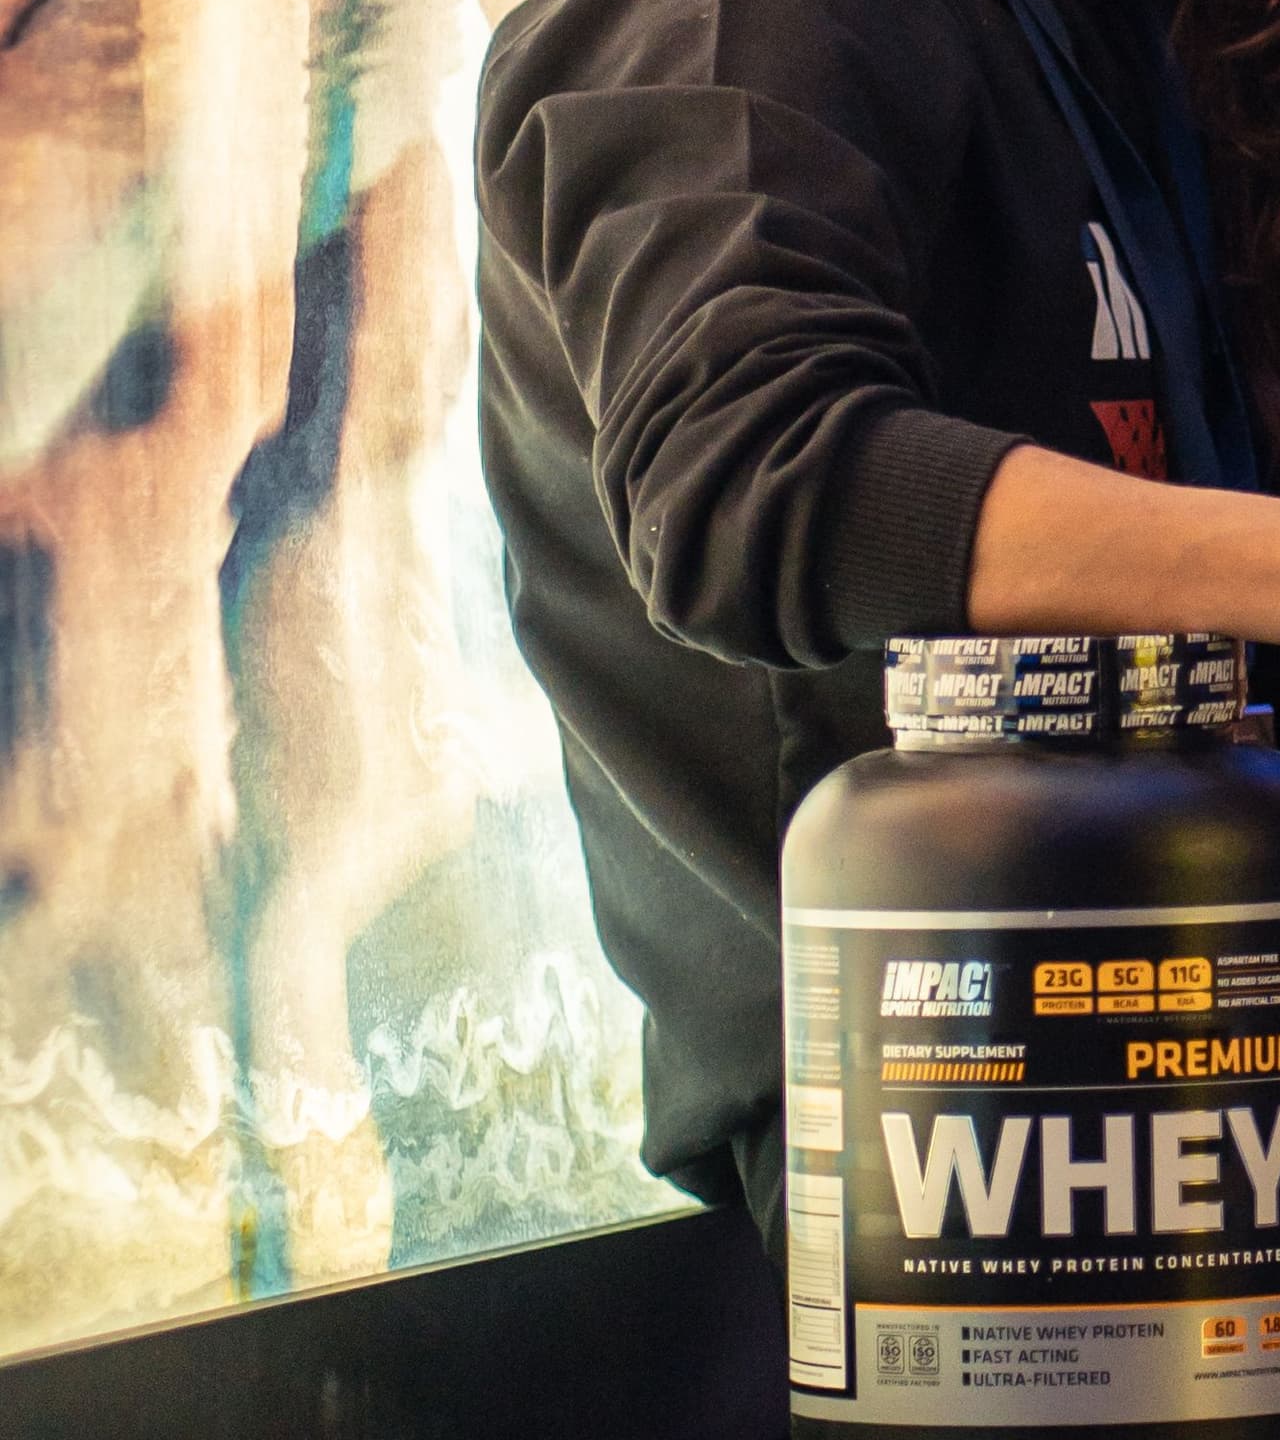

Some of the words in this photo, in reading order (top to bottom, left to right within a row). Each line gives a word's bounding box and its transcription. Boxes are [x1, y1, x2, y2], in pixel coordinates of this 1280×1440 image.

[1041, 654, 1089, 664] NUTRITION
[1042, 696, 1090, 706] NUTRITION
[1044, 969, 1083, 987] 23G
[1217, 978, 1229, 987] NO
[1231, 976, 1256, 987] ADDED
[880, 1001, 921, 1016] SPORT
[921, 1001, 992, 1016] NUTRITION
[1042, 1000, 1085, 1009] PROTEIN
[1113, 999, 1139, 1008] BCAA
[1218, 999, 1229, 1008] NO
[882, 1045, 932, 1058] DIETARY
[935, 1045, 1026, 1058] SUPPLEMENT
[904, 1259, 972, 1274] NATIVE
[982, 1258, 1041, 1274] WHEY
[1052, 1256, 1144, 1273] PROTEIN
[973, 1326, 1033, 1340] NATIVE
[1036, 1325, 1087, 1339] WHEY
[1092, 1323, 1164, 1338] PROTEIN
[1215, 1321, 1235, 1337] 60
[881, 1346, 901, 1357] ISO
[913, 1346, 935, 1358] ISO
[973, 1349, 1012, 1363] FAST
[1018, 1349, 1079, 1363] ACTING
[973, 1371, 1111, 1387] ULTRA-FILTERED
